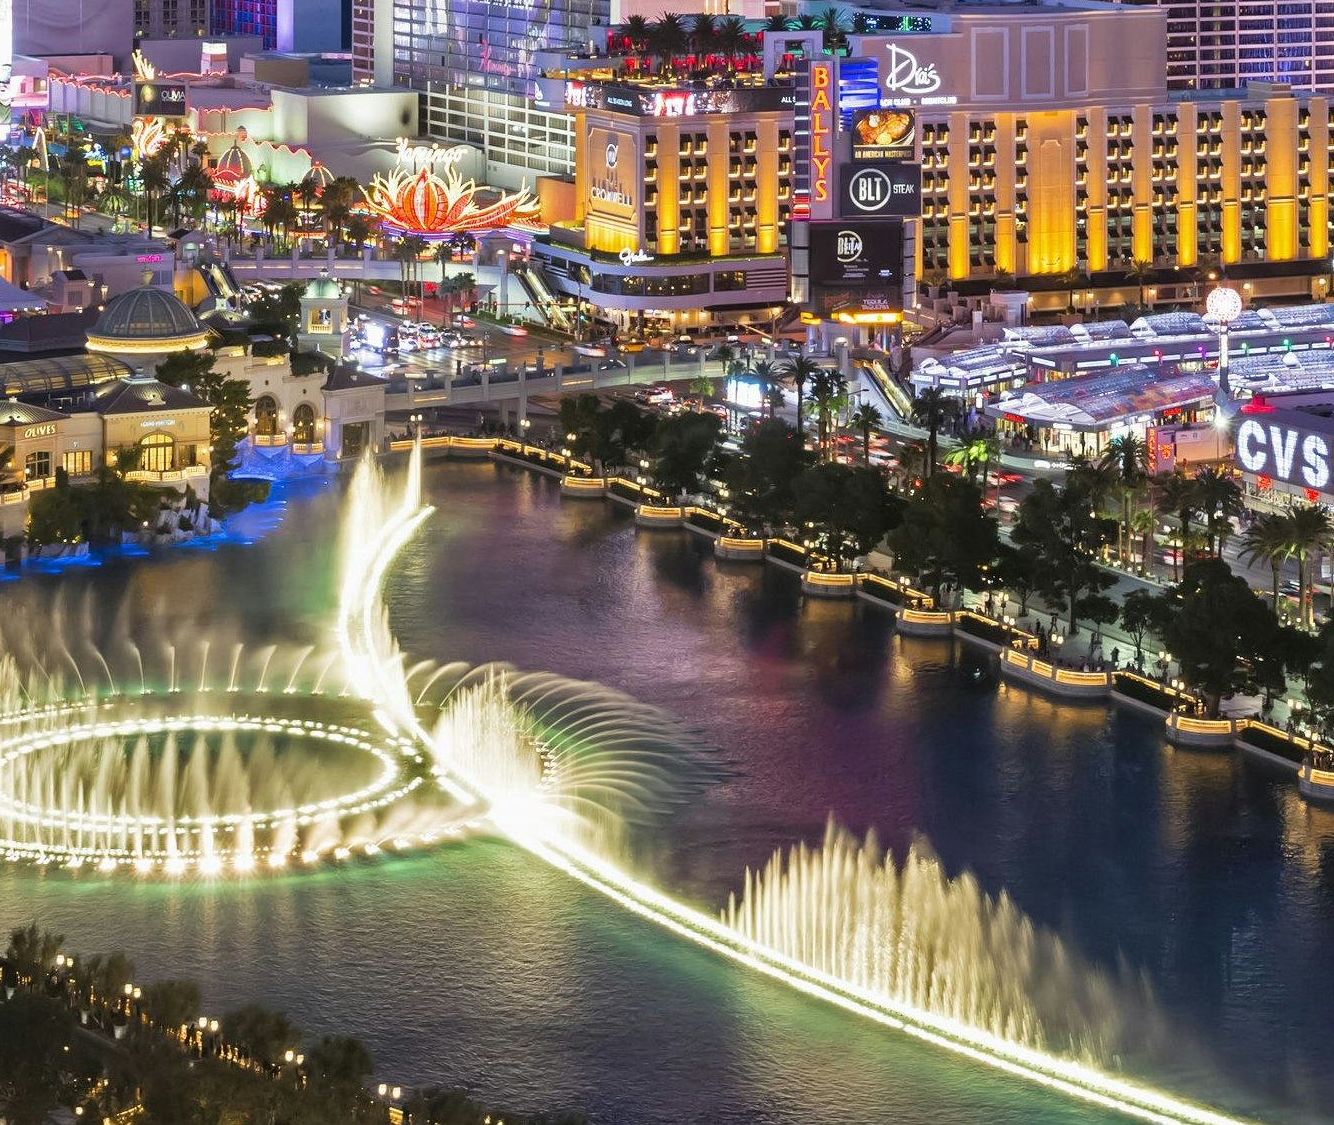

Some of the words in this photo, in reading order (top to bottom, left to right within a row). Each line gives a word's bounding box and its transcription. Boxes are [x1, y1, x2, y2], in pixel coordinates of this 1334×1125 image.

[812, 66, 831, 201] BALLYS
[858, 178, 882, 201] BLT
[893, 183, 915, 194] STEAK
[24, 424, 56, 438] OLIVES
[1237, 419, 1330, 489] CVS
